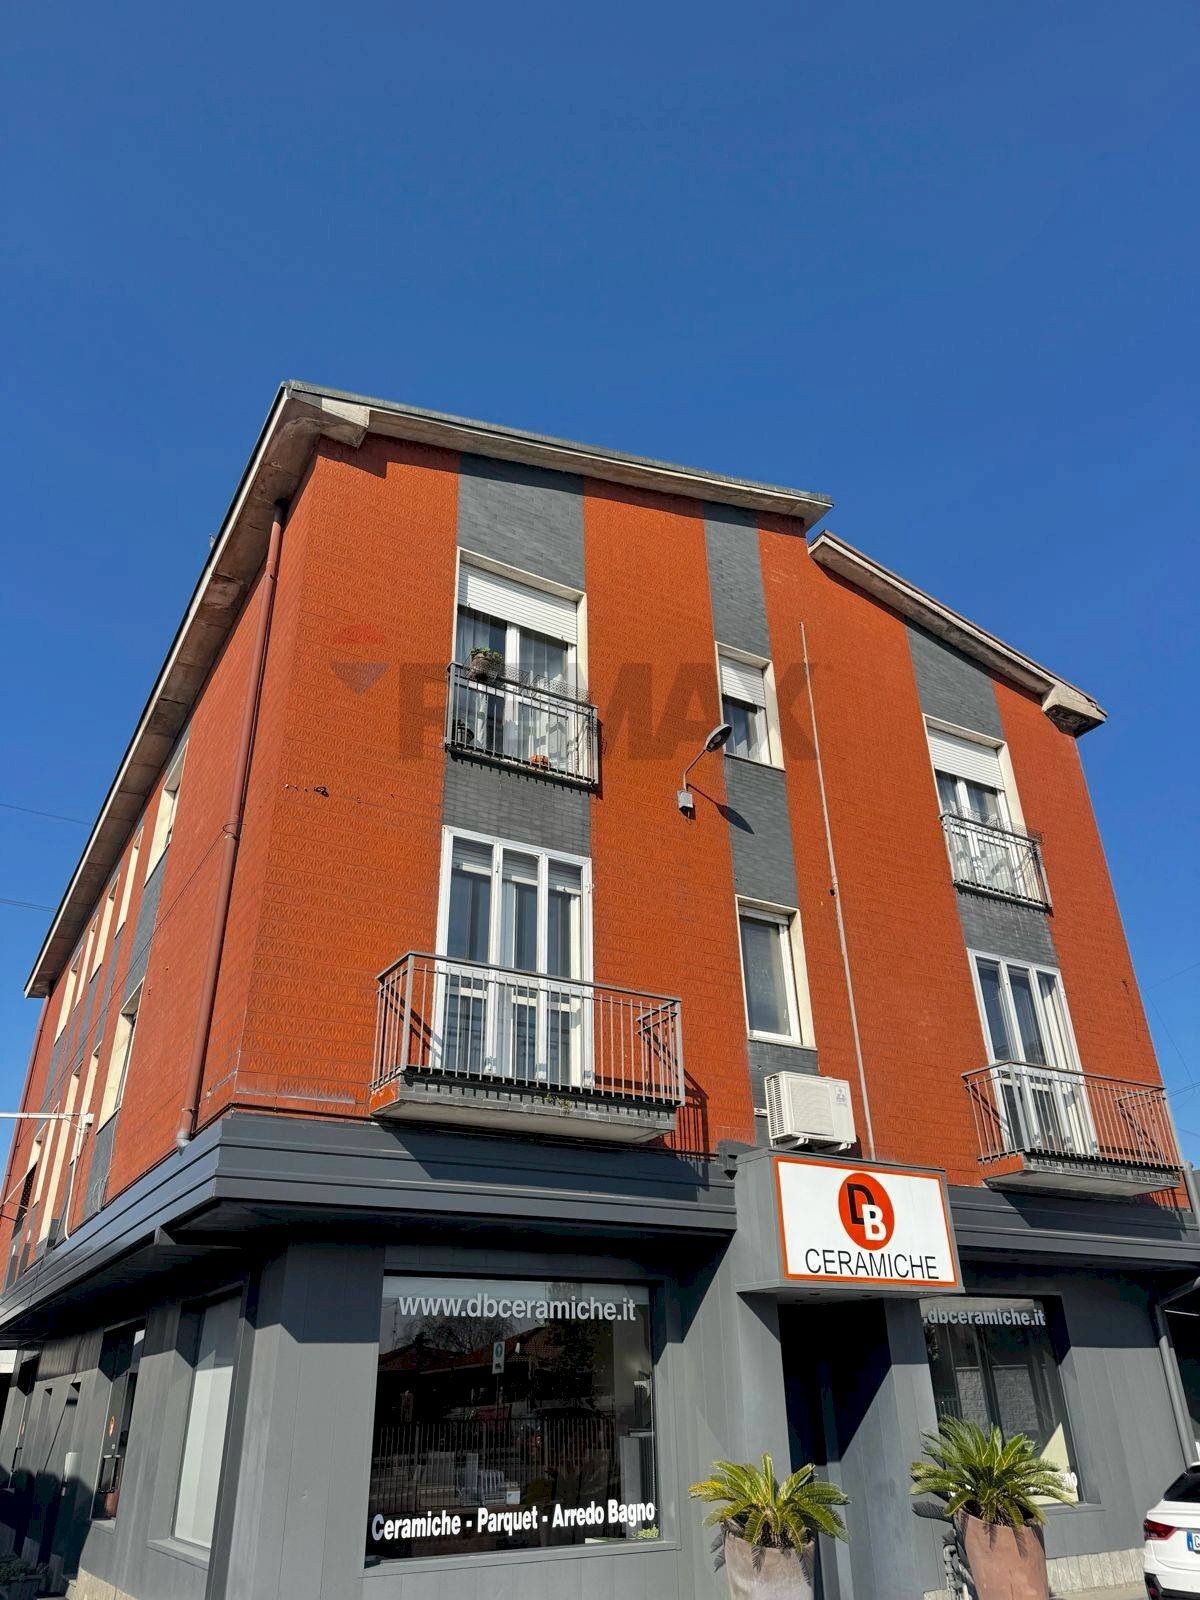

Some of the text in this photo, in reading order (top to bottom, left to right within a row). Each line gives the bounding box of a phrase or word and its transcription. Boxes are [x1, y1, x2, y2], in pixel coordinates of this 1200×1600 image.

[846, 1182, 887, 1241] DB
[805, 1248, 940, 1280] CERAMICHE
[399, 1293, 636, 1321] www.dbceramiche.it
[371, 1510, 461, 1541] Ceramiche
[477, 1506, 538, 1536] Parquet
[552, 1501, 605, 1528] Arredo
[607, 1498, 655, 1528] Bagno
